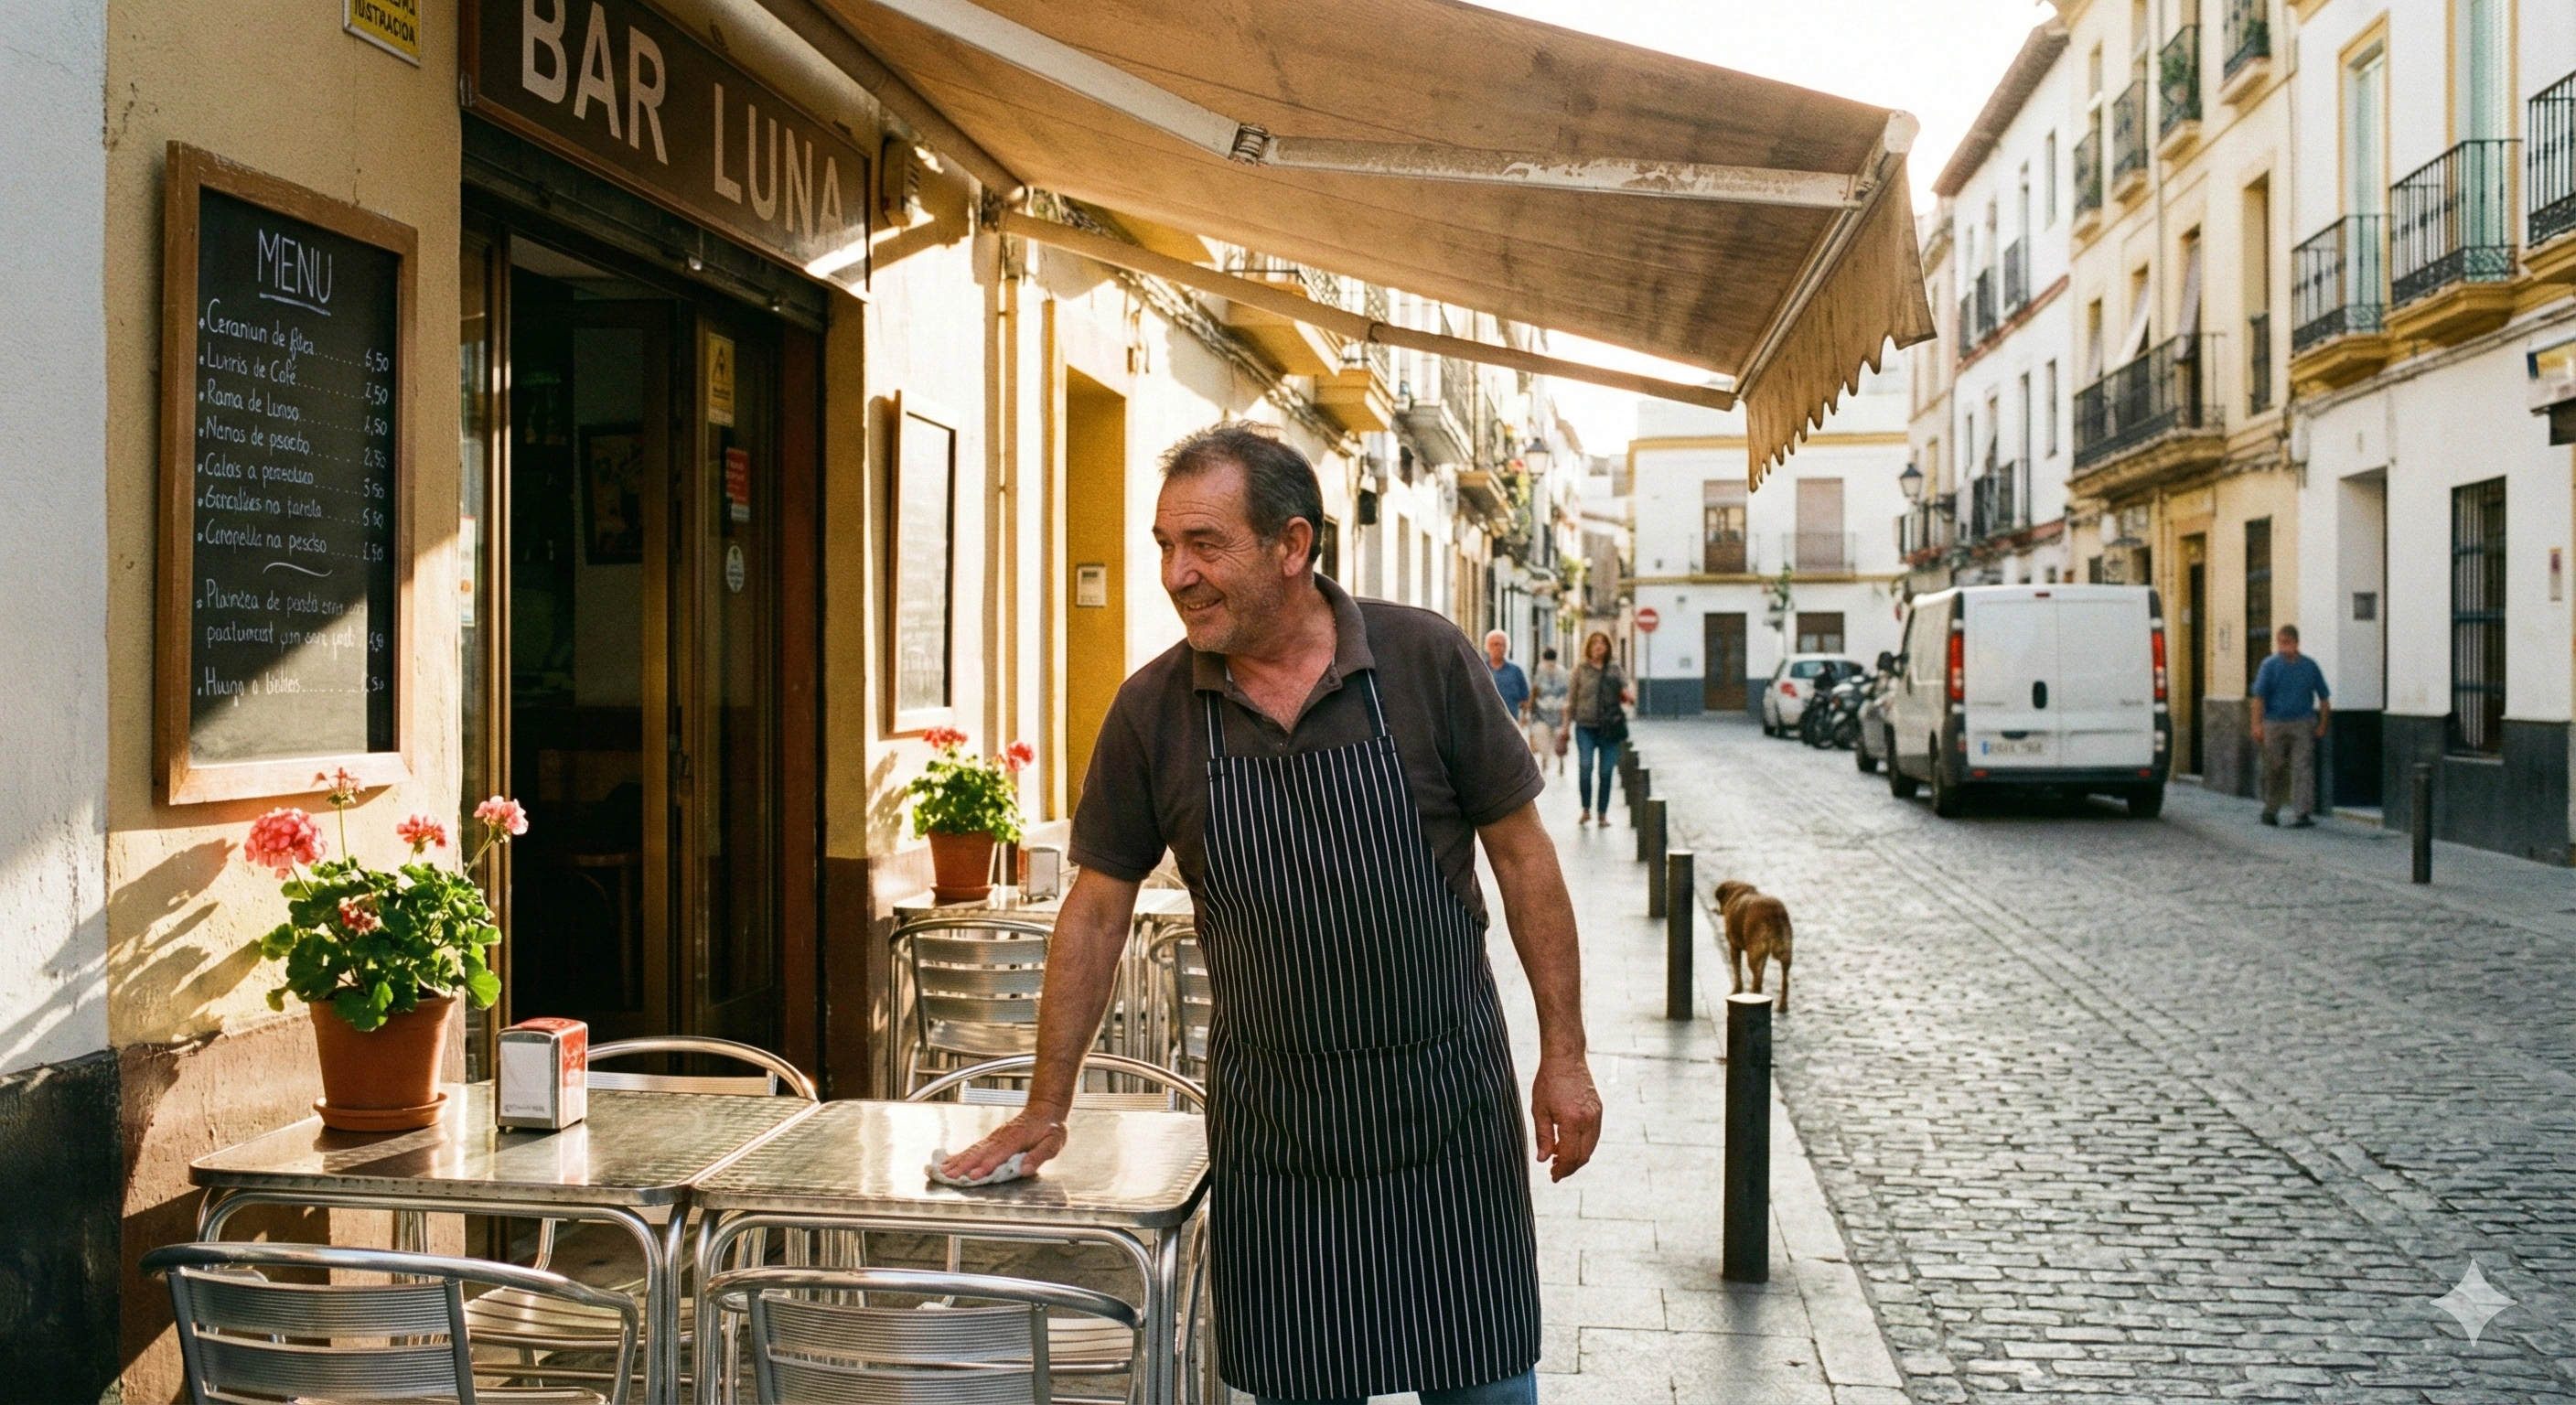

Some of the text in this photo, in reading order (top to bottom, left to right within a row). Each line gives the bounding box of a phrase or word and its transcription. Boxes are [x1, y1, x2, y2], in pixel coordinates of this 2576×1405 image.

[521, 0, 844, 243] BAR LUNA
[258, 229, 332, 304] MENU
[273, 319, 285, 347] de
[248, 388, 262, 413] de
[251, 424, 263, 446] de
[267, 590, 280, 611] de
